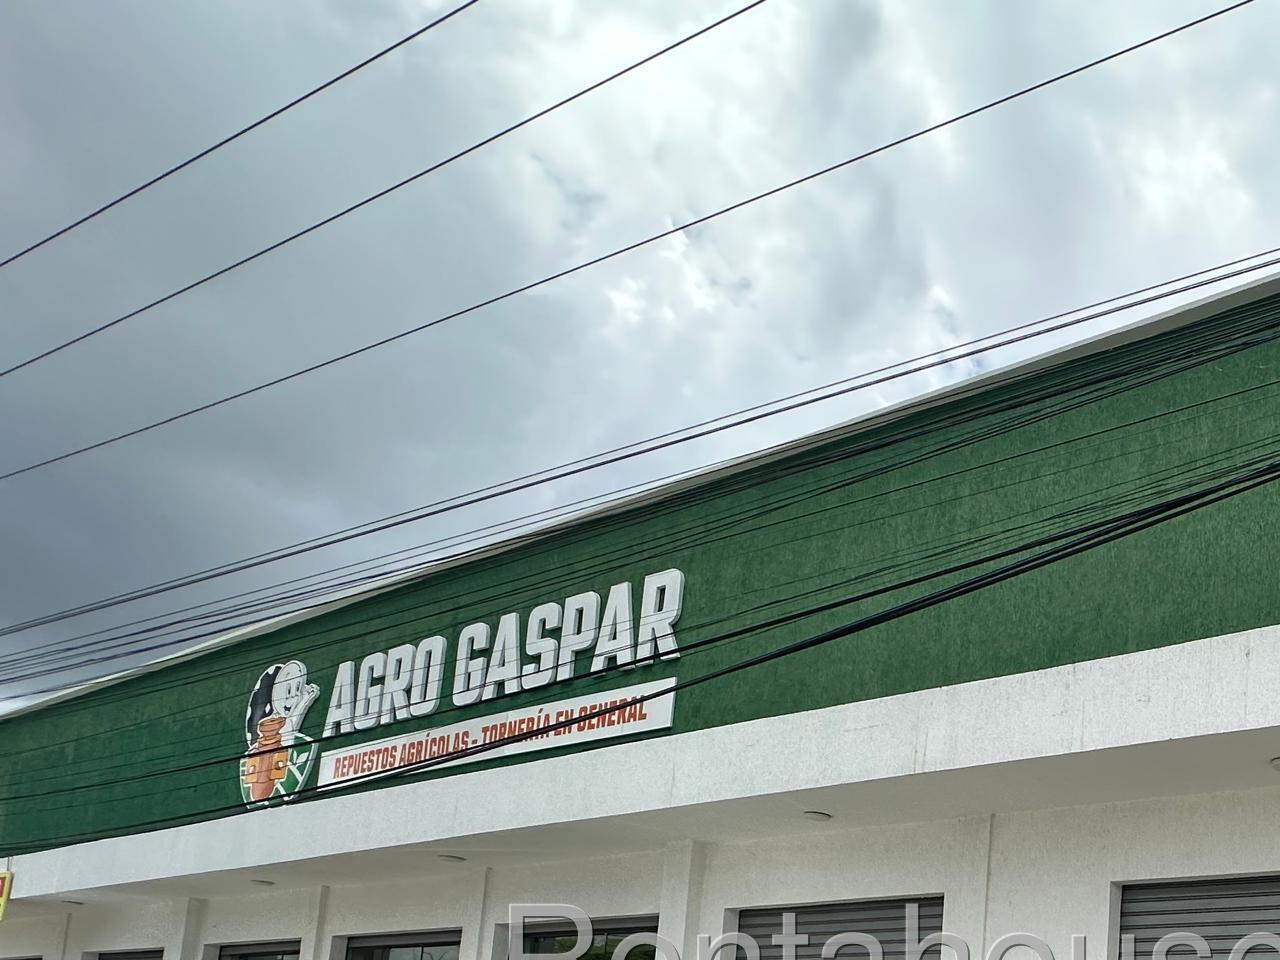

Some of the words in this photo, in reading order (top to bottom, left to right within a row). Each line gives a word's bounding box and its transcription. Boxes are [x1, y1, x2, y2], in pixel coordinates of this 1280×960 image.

[322, 635, 447, 739] AGRO
[453, 568, 685, 707] GASPAR
[333, 744, 398, 779] REPUESTOS
[399, 730, 470, 767] AGRÍCOLAS
[553, 709, 575, 737] EN
[577, 694, 648, 733] GENERAL
